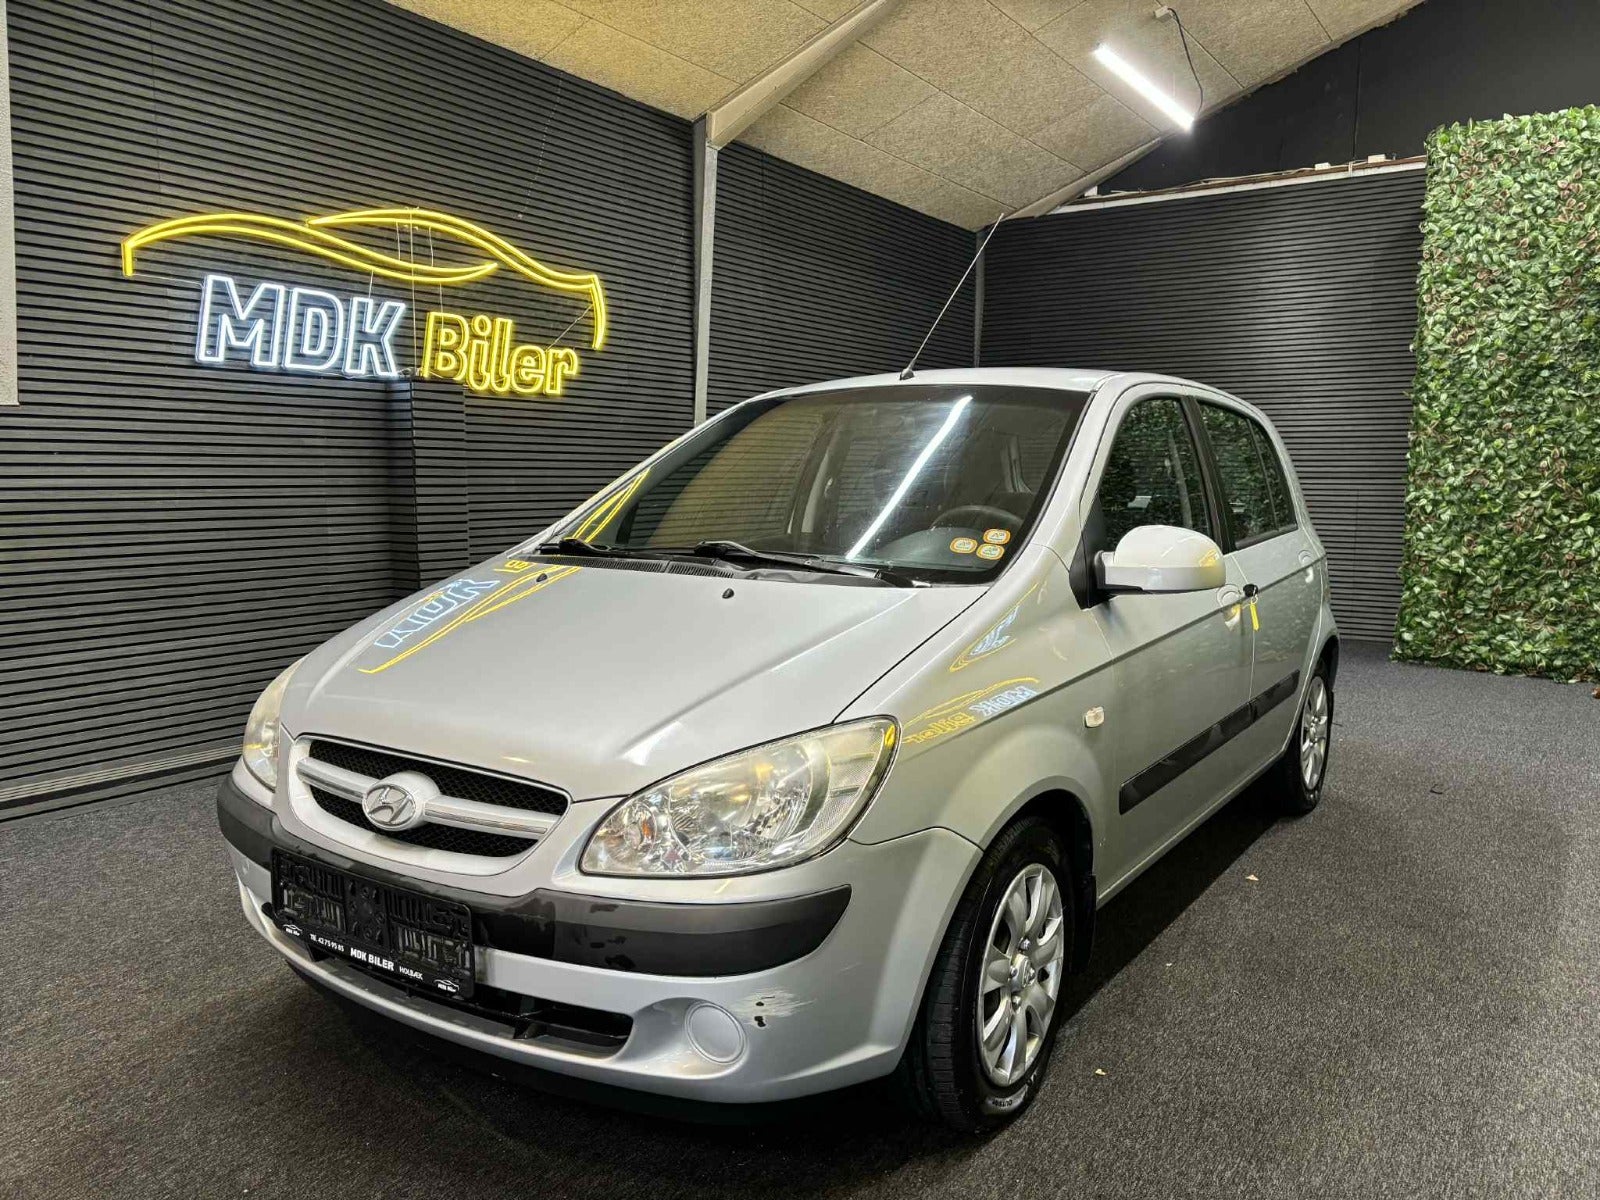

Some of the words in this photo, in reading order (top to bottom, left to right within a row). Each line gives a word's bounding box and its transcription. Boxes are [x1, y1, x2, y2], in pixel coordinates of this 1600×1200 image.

[195, 275, 406, 377] MDK
[421, 311, 580, 396] Biler
[350, 947, 367, 961] MDK
[368, 954, 394, 971] BILER
